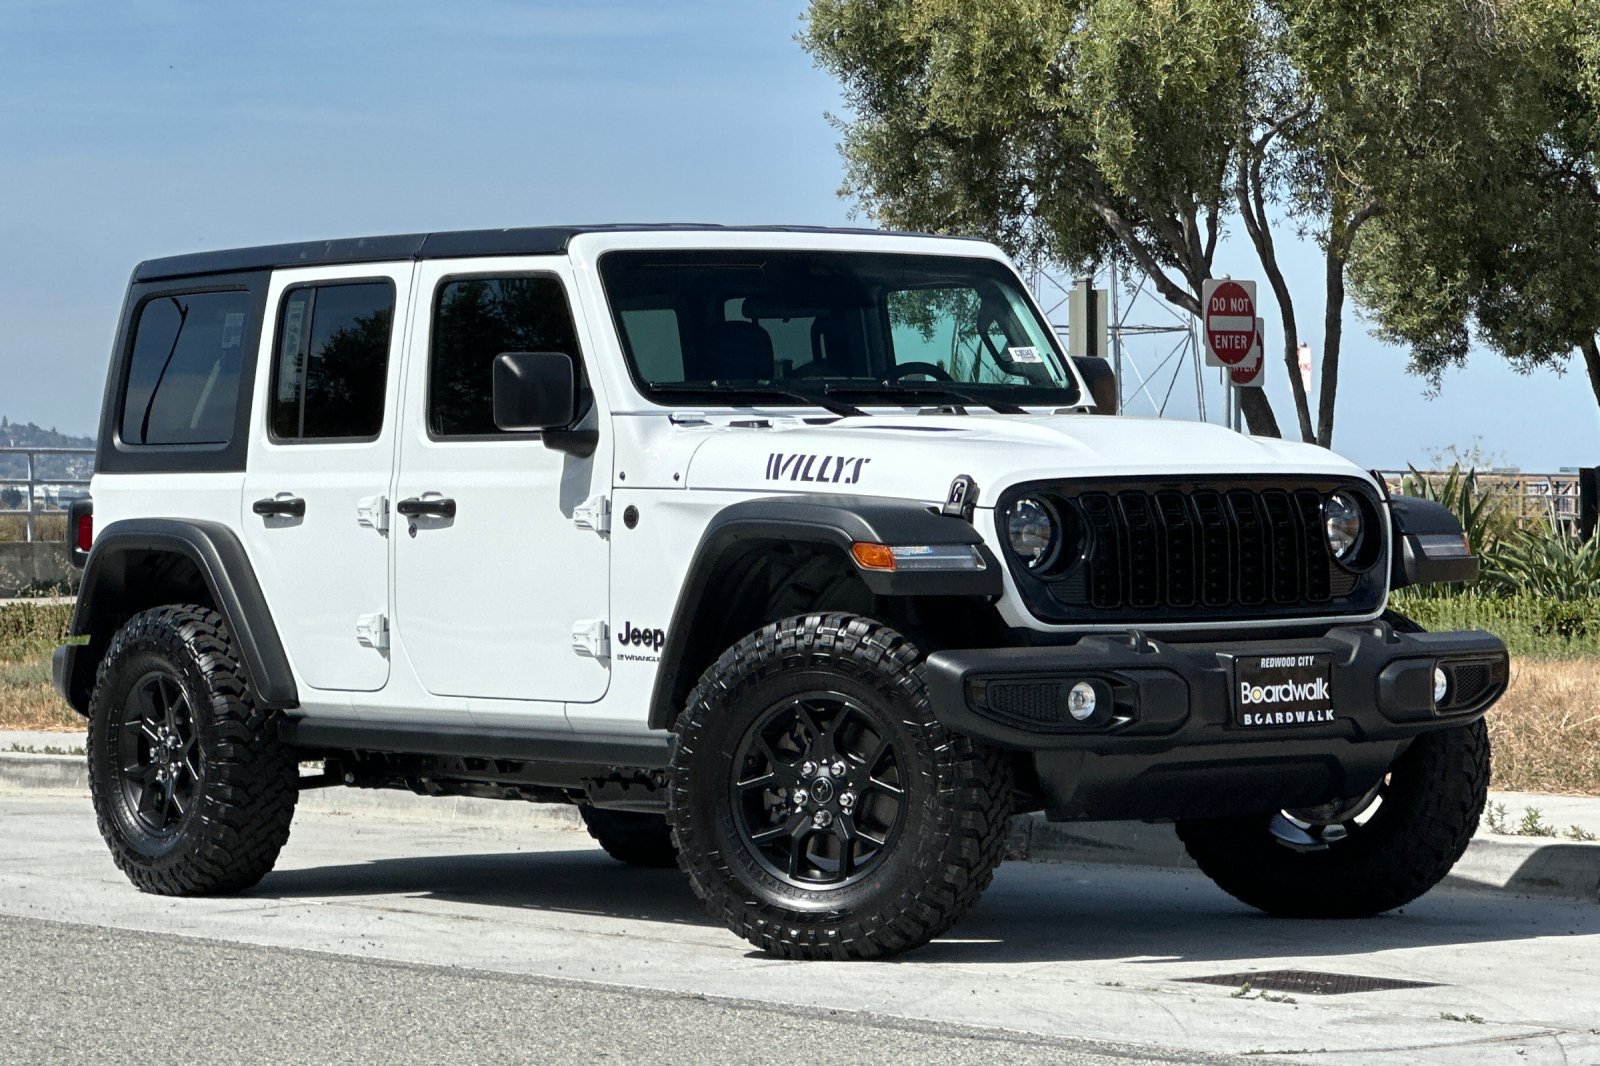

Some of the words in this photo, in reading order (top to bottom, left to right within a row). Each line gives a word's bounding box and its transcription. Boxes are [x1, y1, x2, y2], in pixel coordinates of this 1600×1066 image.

[1212, 298, 1226, 312] DO
[1230, 298, 1249, 312] NOT
[1215, 335, 1247, 349] ENTER
[765, 453, 871, 484] WILLYS
[618, 621, 665, 652] Jeep
[624, 654, 661, 662] WRANGLE
[1260, 657, 1295, 668] REDWOOD
[1298, 656, 1314, 667] CITY
[1241, 677, 1330, 704] Boardwalk
[1244, 709, 1334, 725] BOARDWALK
